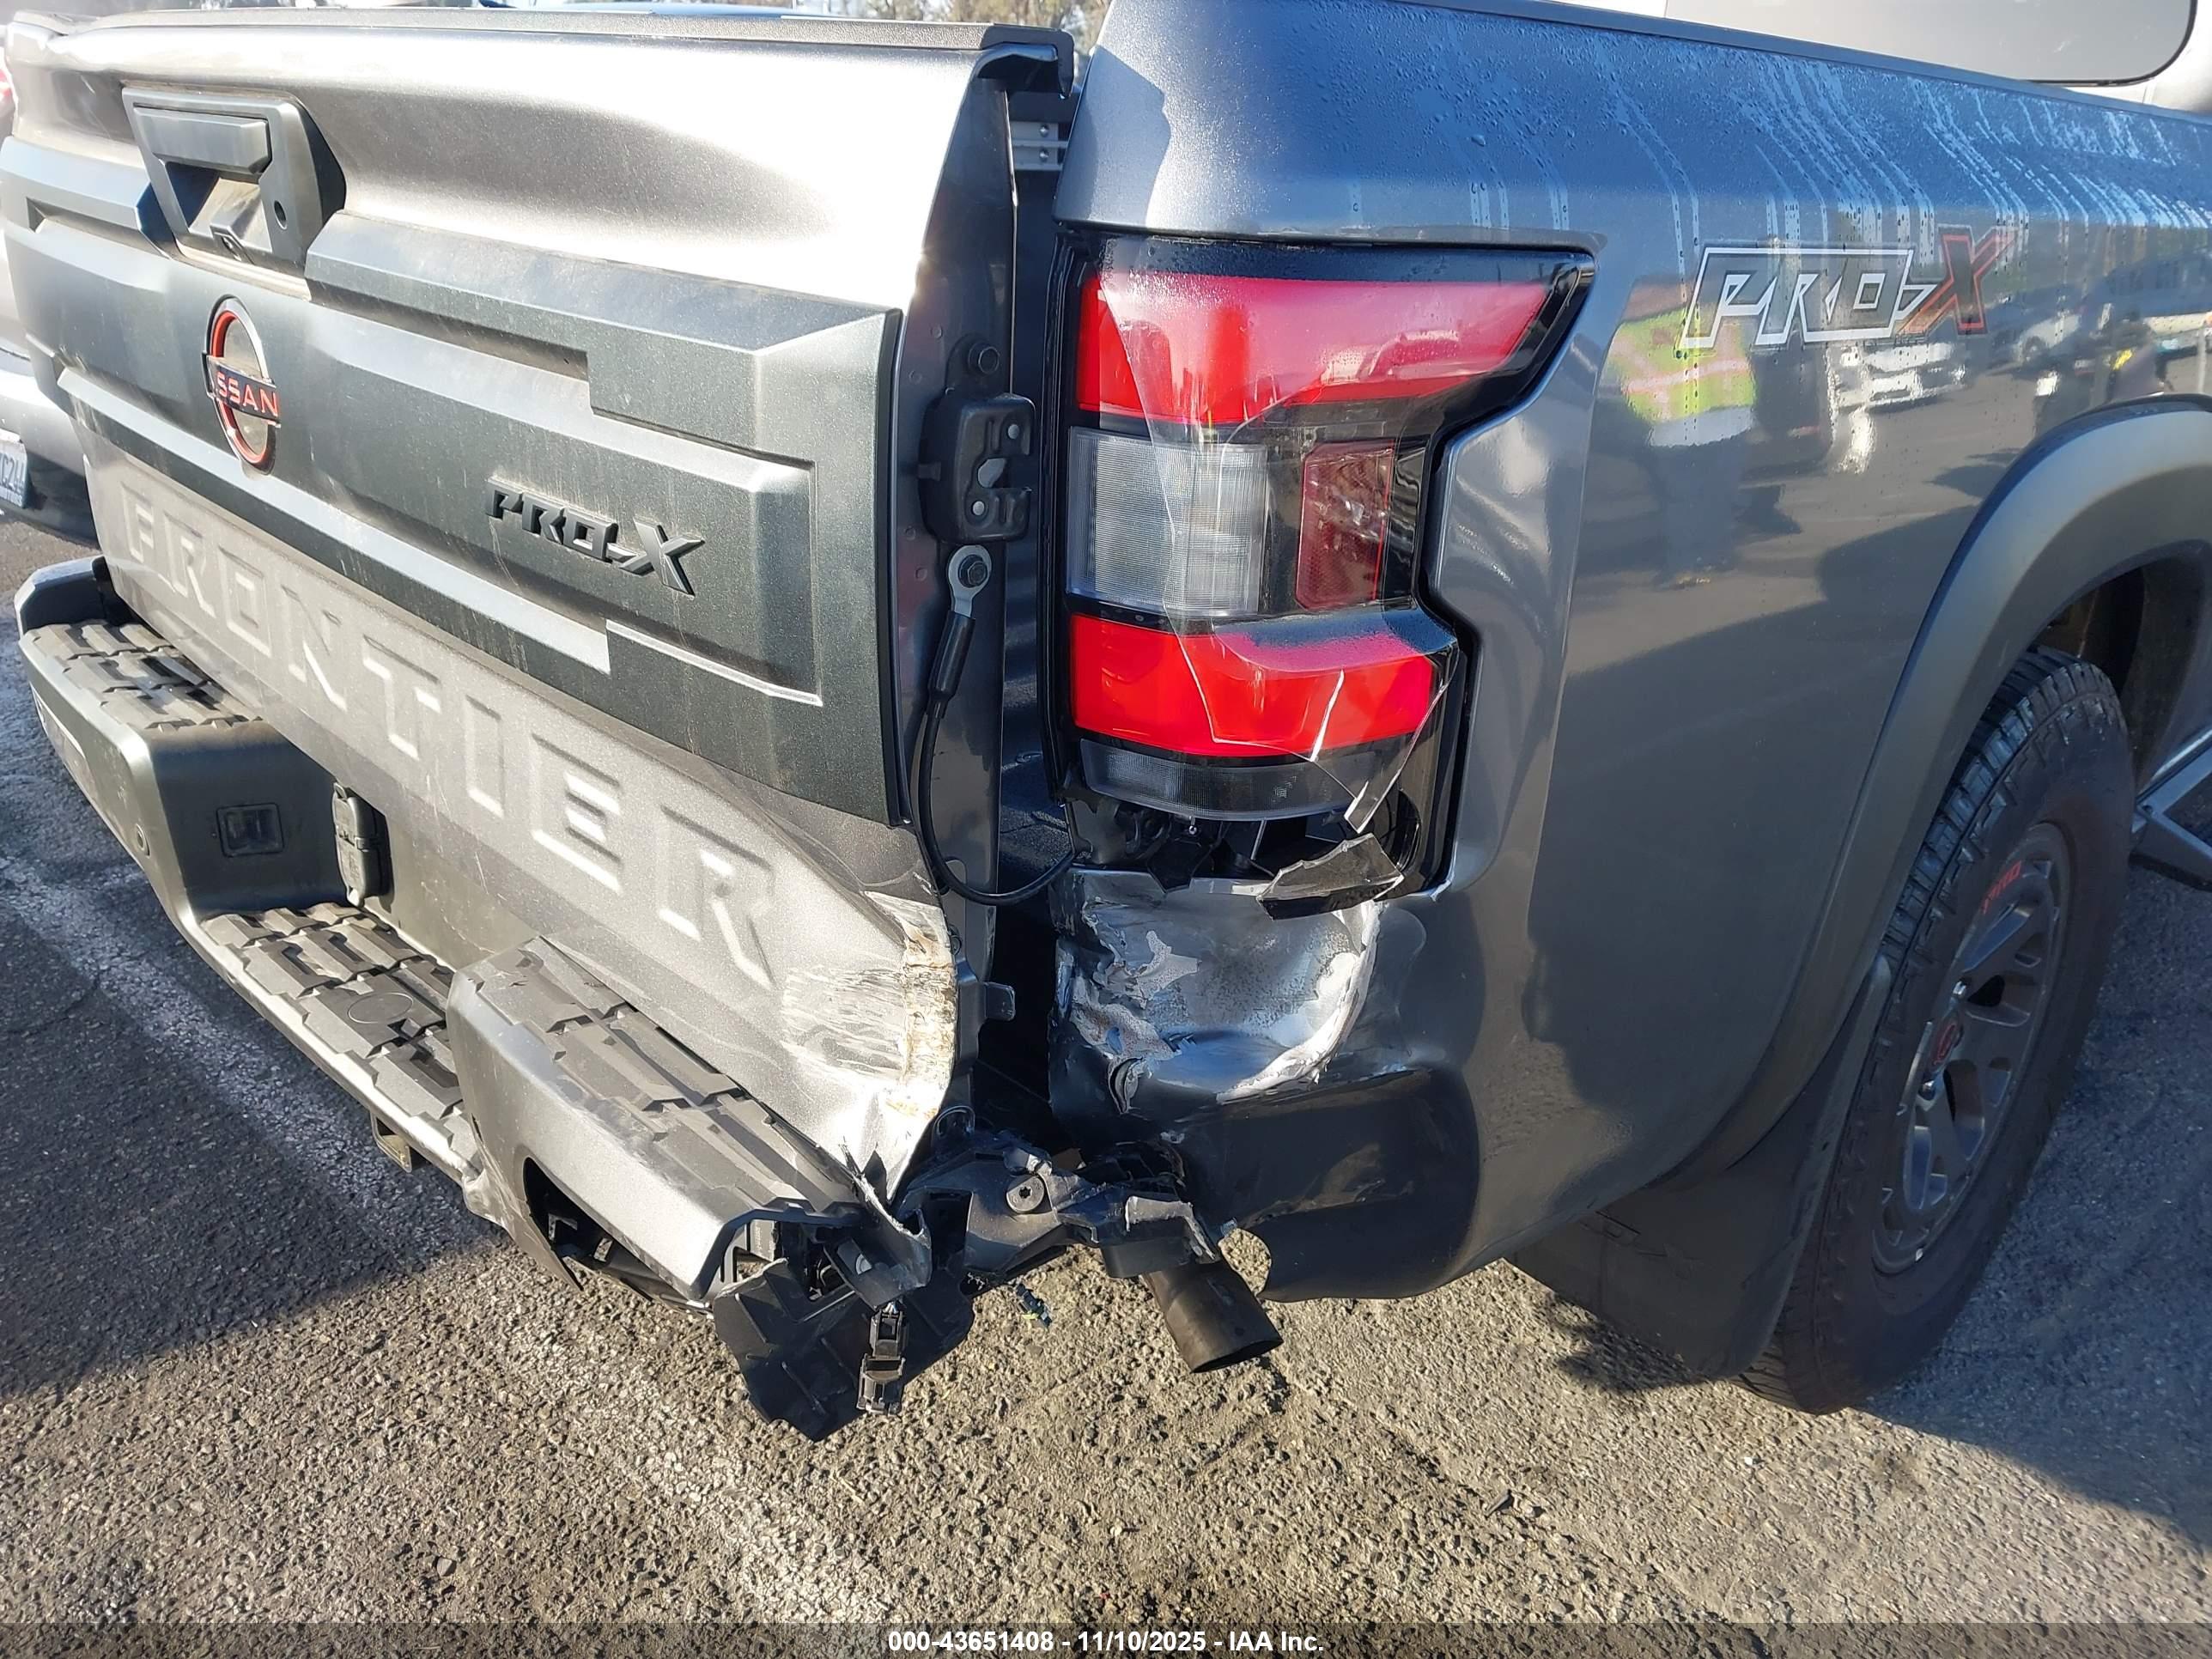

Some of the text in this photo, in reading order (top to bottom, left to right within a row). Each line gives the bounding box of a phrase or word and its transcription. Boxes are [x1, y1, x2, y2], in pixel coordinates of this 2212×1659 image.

[216, 371, 280, 418] SSAN
[484, 475, 707, 599] PRO-X
[120, 478, 777, 989] FRONTIER
